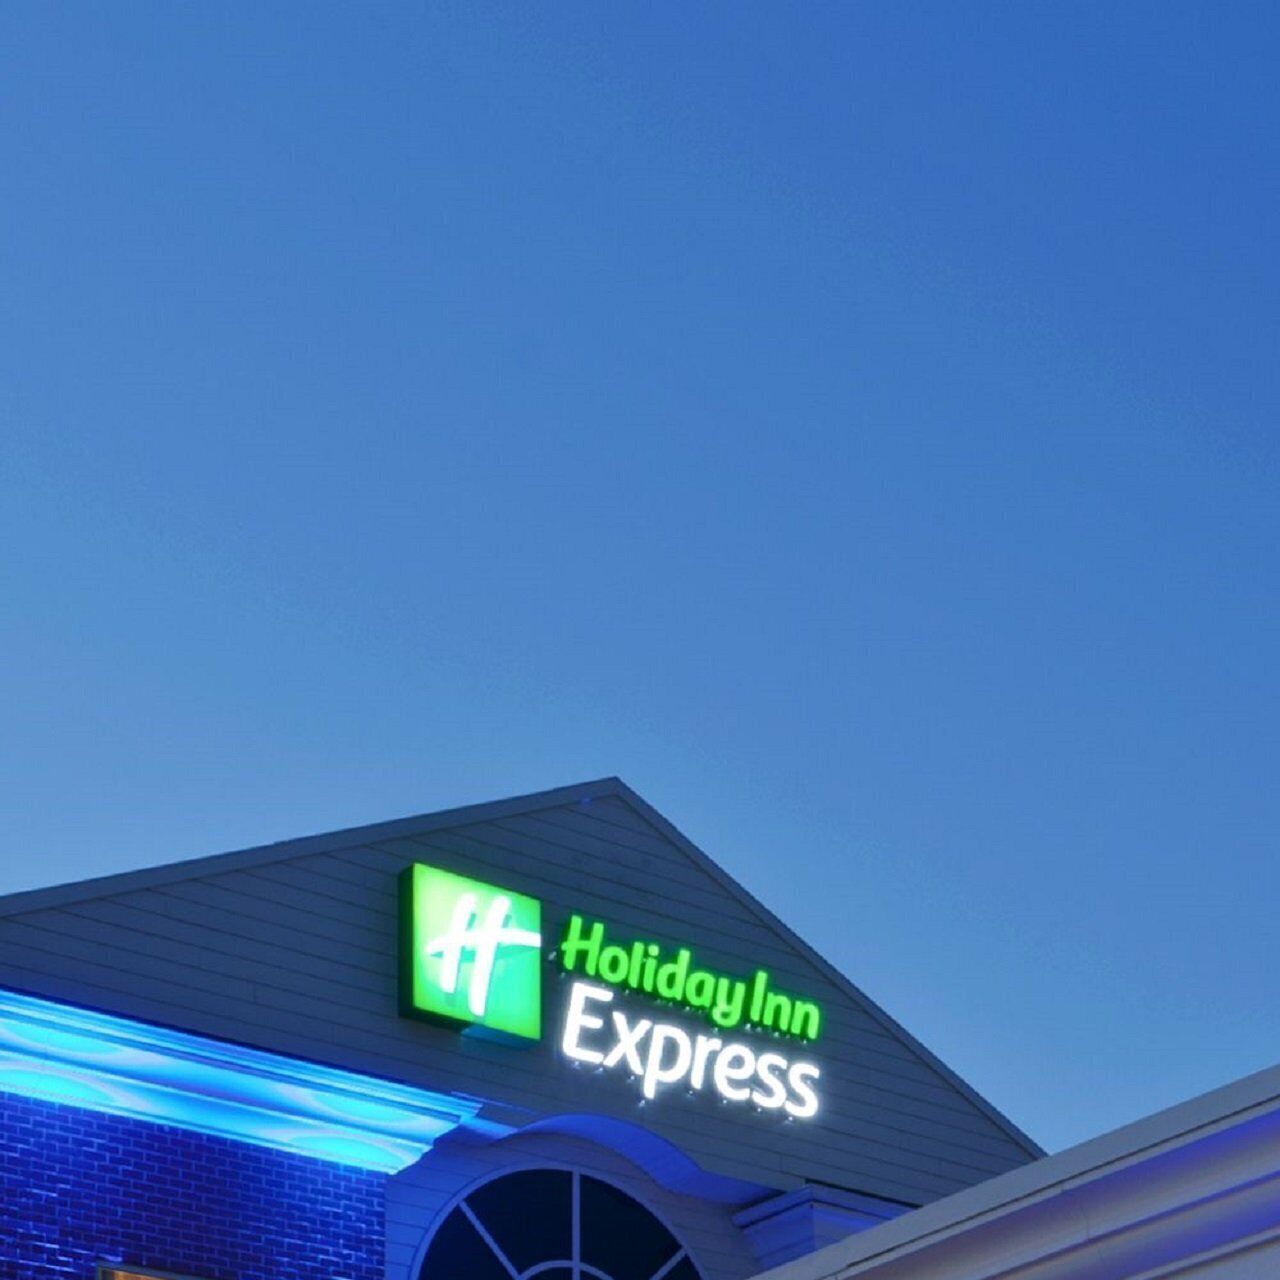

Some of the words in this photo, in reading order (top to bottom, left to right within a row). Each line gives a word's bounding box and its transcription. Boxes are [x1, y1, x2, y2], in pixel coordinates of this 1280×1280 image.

[561, 914, 746, 1028] Holiday
[750, 969, 821, 1040] Inn
[561, 982, 821, 1119] Express
